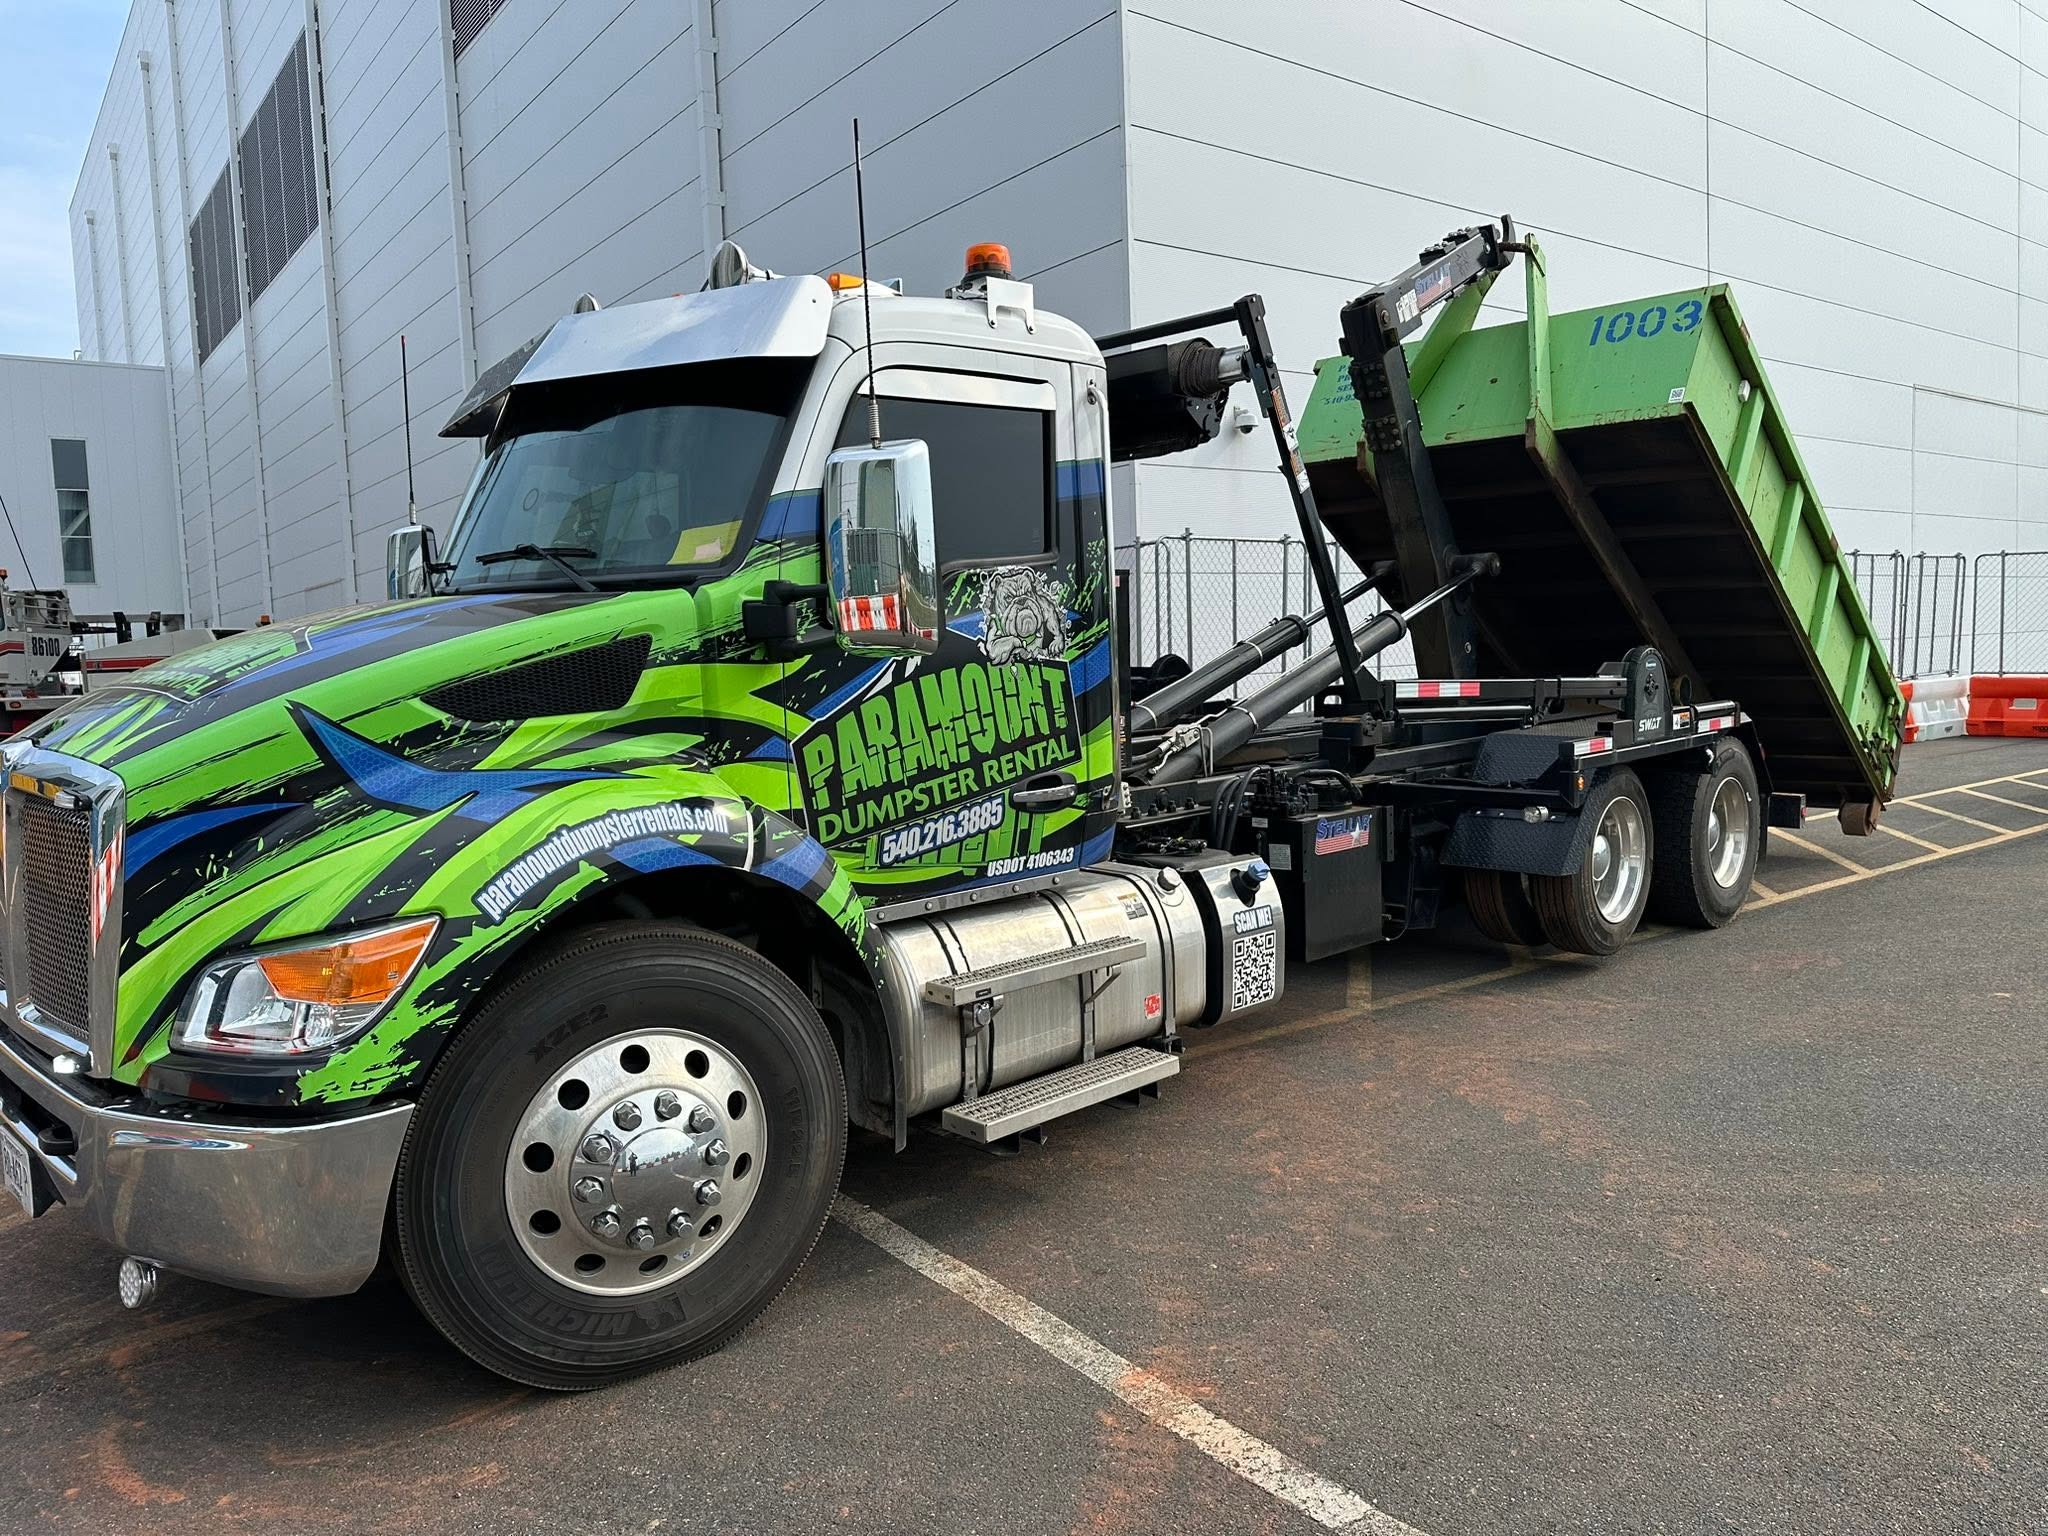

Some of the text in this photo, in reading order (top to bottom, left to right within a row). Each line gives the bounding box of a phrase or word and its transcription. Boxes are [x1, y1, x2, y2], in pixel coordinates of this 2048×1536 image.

[1589, 300, 1703, 347] 1003
[31, 636, 61, 657] 86100
[802, 661, 1068, 810] PARAMOUNT
[1638, 716, 1662, 732] SWAT
[817, 735, 1075, 844] DUMPSTER RENTAL
[881, 797, 1003, 864] 540.216.3885
[1316, 814, 1372, 840] STELLAR
[476, 801, 729, 922] paramountdumpsterrentals.com
[986, 847, 1075, 878] USDOT 4106343
[1234, 905, 1273, 934] SCAN ME!
[471, 1239, 635, 1338] MICHELIN
